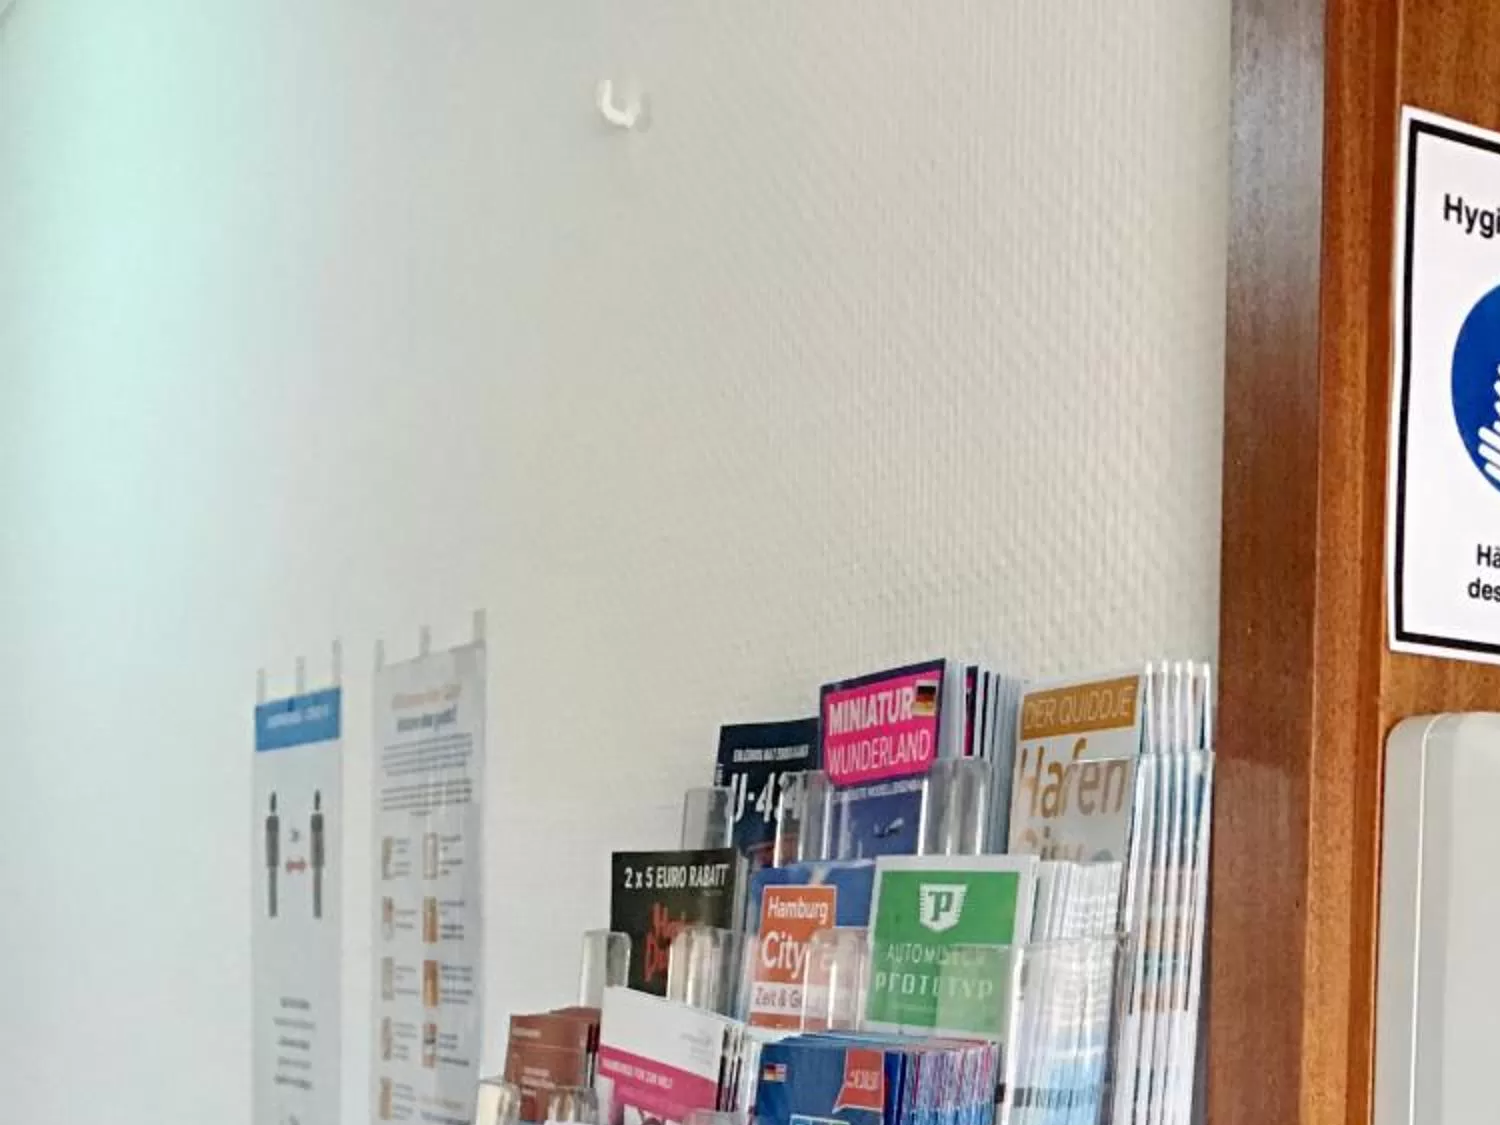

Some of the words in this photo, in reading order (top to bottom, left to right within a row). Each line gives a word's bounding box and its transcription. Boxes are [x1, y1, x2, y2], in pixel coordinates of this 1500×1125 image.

[829, 686, 913, 736] MINIATUR
[828, 729, 931, 776] WUNDERLAND
[1020, 737, 1129, 819] Hafen
[624, 867, 633, 889] 2
[645, 866, 654, 888] 5
[656, 865, 687, 889] EURO
[689, 863, 730, 888] RABATT
[768, 895, 829, 924] Hamburg
